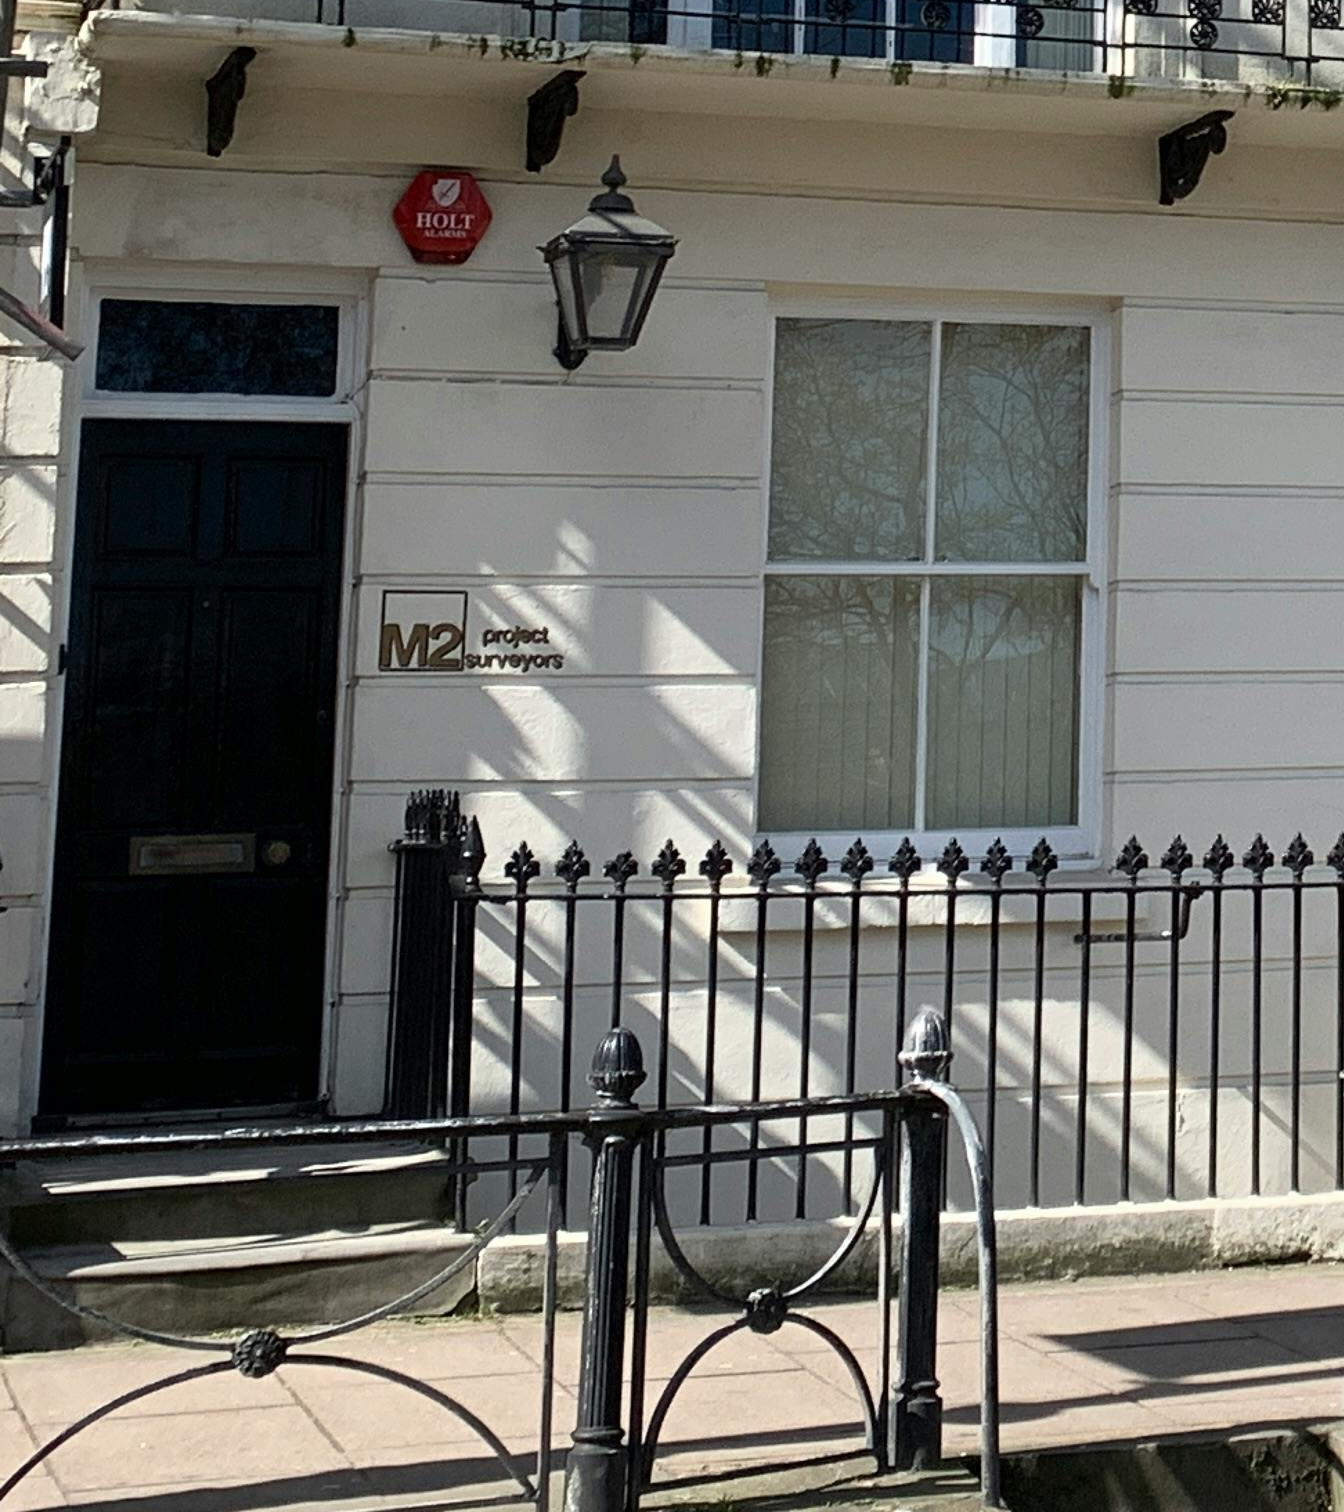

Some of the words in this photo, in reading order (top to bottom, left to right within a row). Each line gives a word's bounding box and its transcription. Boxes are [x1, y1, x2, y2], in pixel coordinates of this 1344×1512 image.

[415, 212, 475, 230] HOLT
[423, 229, 467, 238] ALARMS
[380, 623, 463, 668] M2
[482, 625, 549, 648] project
[463, 653, 564, 673] surveyors
